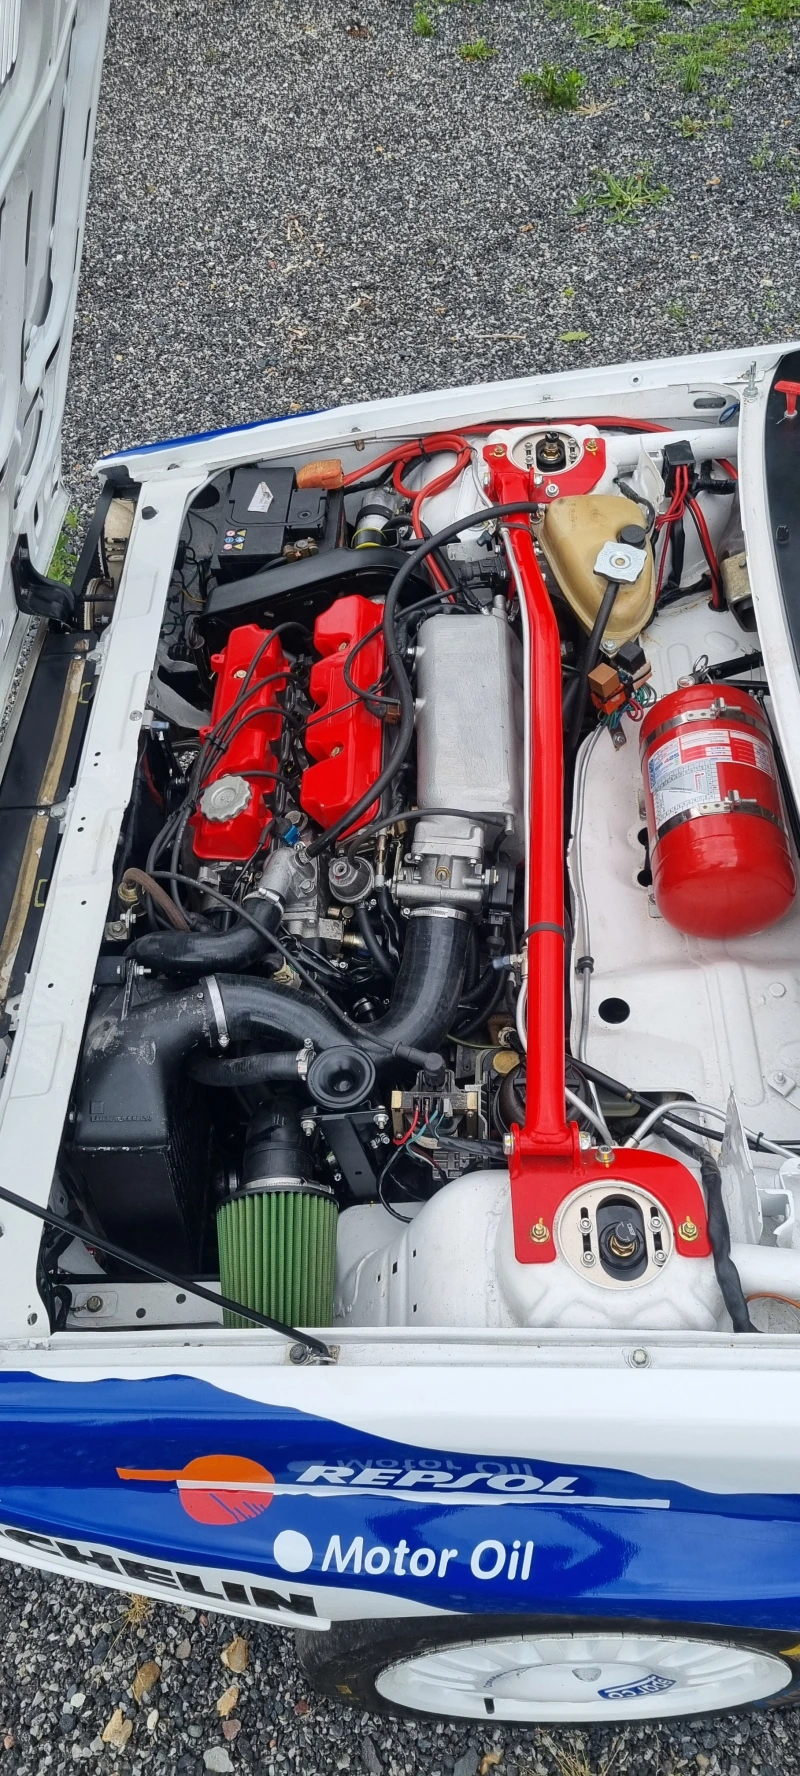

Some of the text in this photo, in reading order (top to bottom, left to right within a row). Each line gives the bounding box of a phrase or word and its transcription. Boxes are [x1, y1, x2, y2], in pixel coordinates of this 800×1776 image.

[296, 1465, 579, 1494] REPSOL
[0, 1529, 318, 1617] CHELIN
[321, 1535, 534, 1581] Motor Oil
